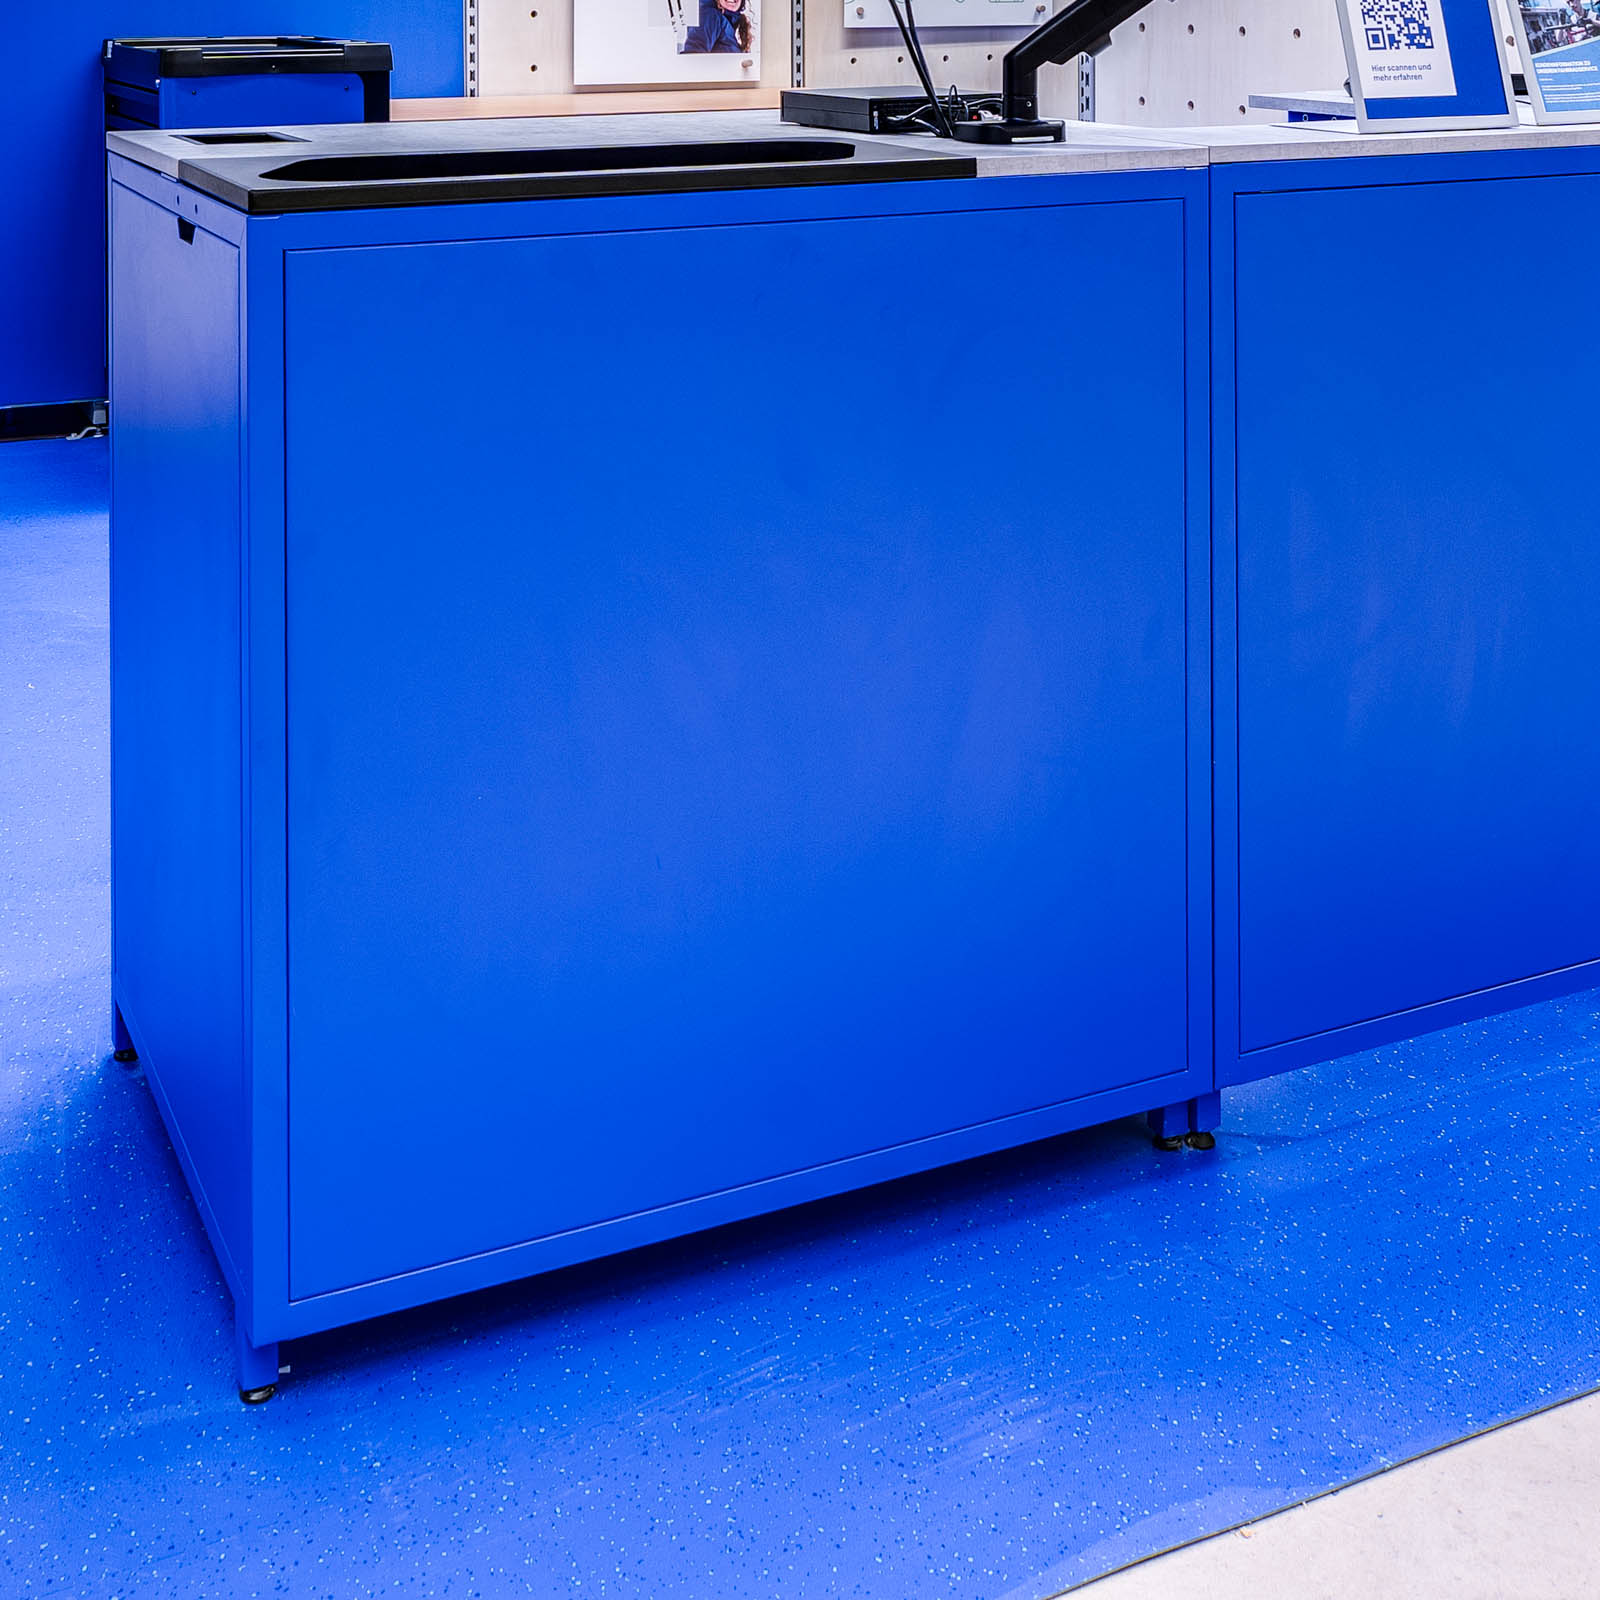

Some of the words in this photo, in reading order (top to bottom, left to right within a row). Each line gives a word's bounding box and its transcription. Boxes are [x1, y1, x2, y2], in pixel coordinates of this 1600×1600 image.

[1371, 64, 1386, 72] Hier
[1387, 64, 1417, 72] scannen
[1418, 63, 1432, 71] und
[1373, 73, 1392, 81] mehr
[1393, 73, 1423, 81] erfahren
